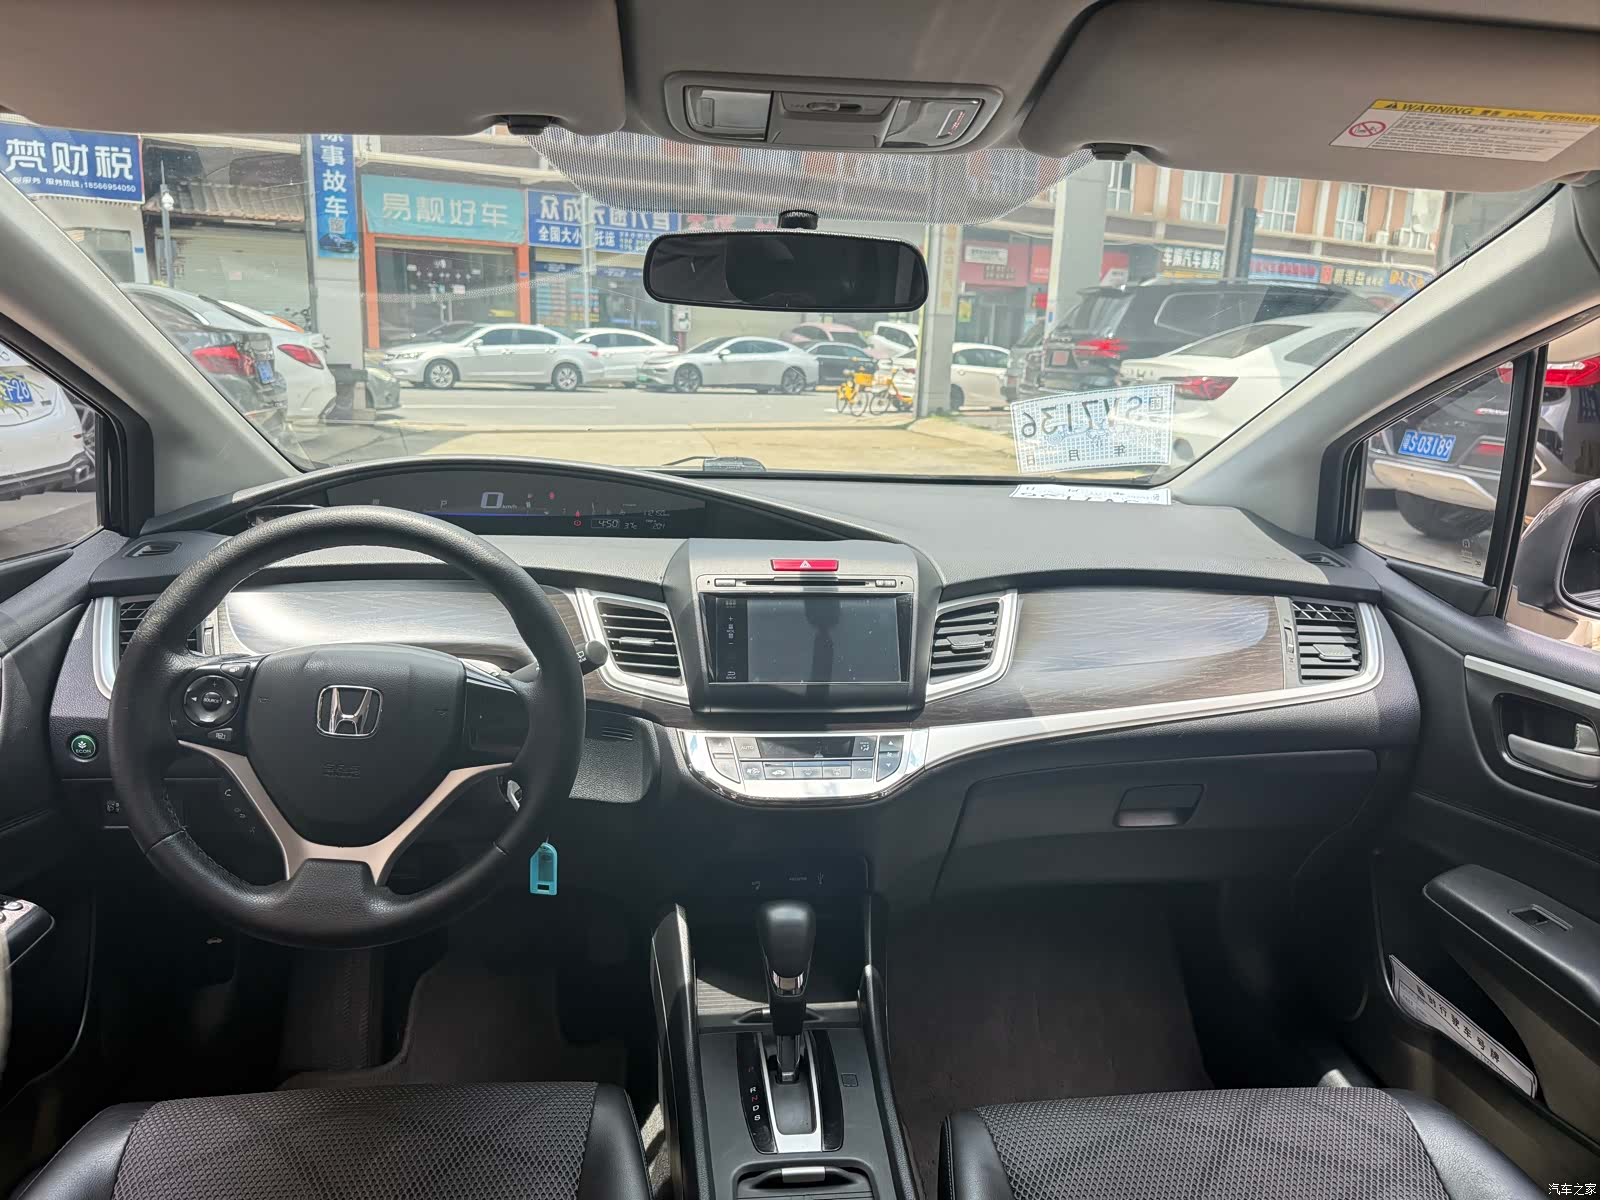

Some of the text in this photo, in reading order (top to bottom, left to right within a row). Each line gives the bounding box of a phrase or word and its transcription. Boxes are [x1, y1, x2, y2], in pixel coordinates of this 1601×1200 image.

[1400, 102, 1473, 116] WARNING
[5, 138, 134, 180] 梵财税
[383, 192, 509, 228] 易靓好车
[538, 225, 616, 247] 全国大小托运
[480, 491, 504, 509] 0
[598, 519, 619, 529] 4:50
[202, 696, 220, 704] SOURCE
[749, 1086, 757, 1094] R
[752, 1104, 760, 1112] D
